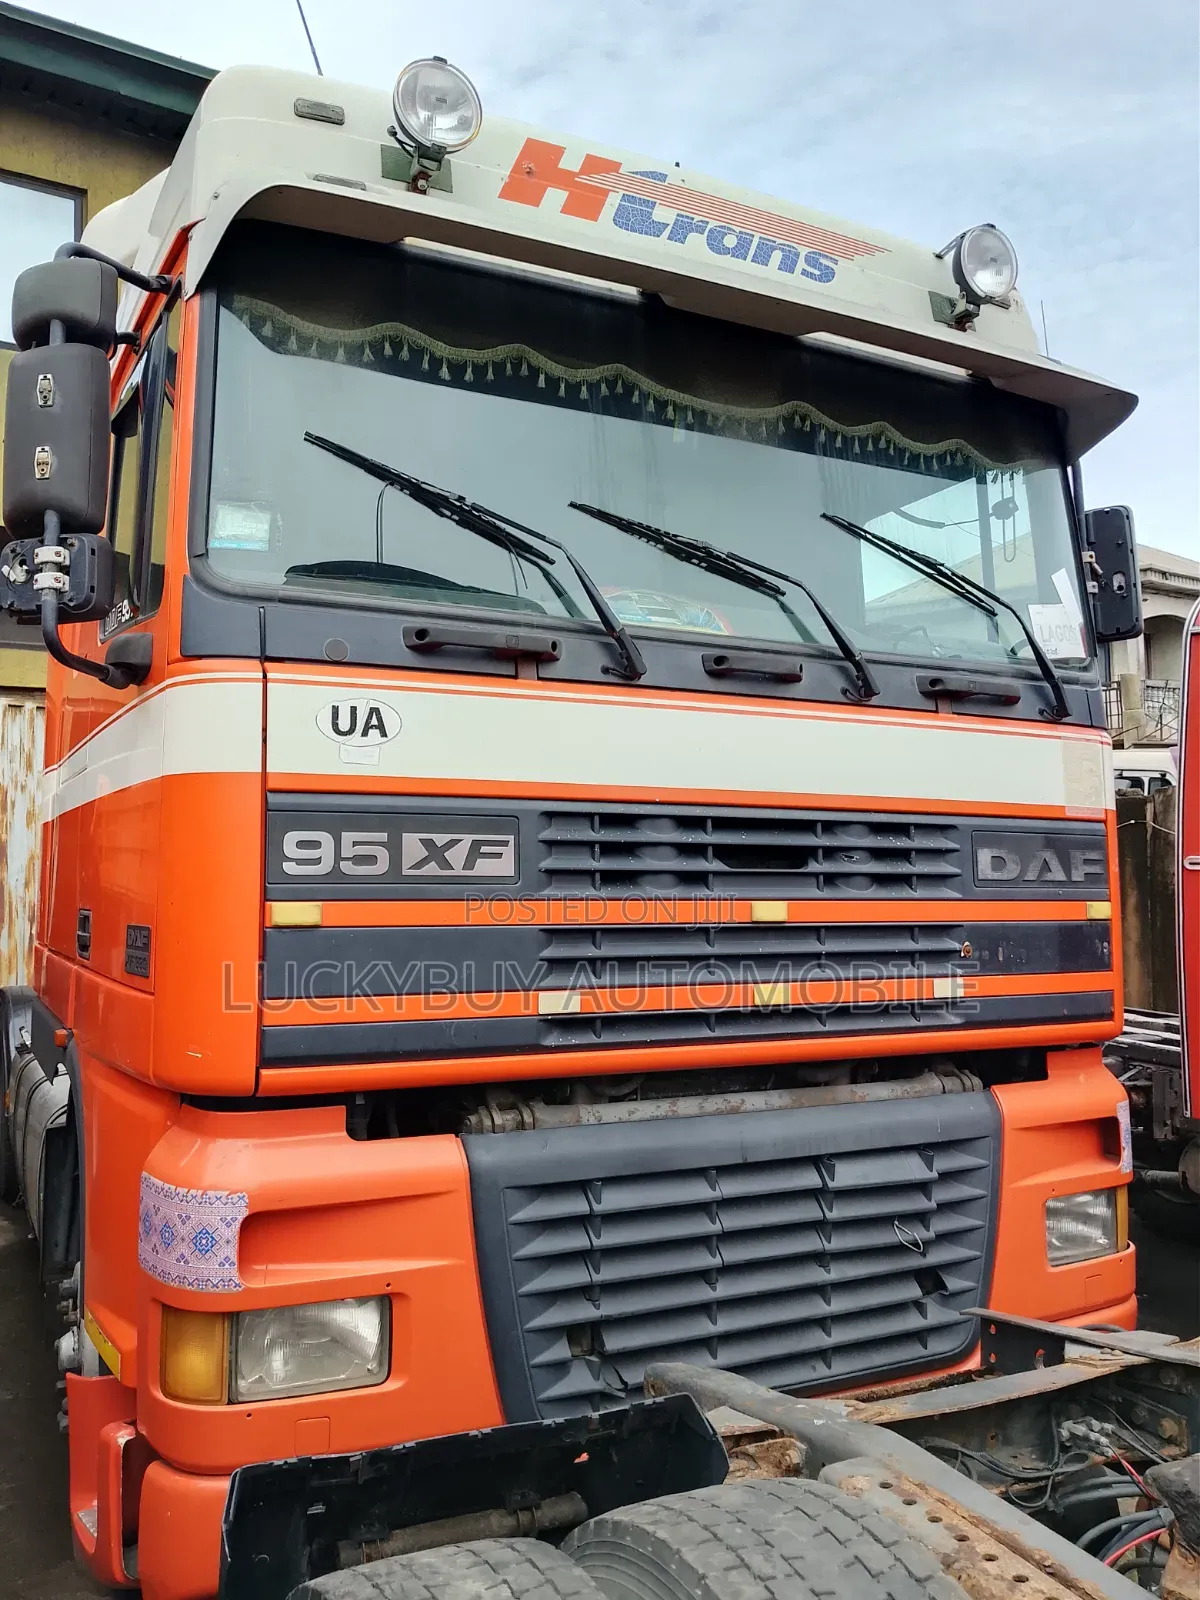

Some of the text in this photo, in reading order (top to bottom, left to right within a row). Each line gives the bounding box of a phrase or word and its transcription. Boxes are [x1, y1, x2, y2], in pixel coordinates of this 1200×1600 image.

[331, 704, 388, 738] UA
[282, 831, 510, 876] 95 XF
[976, 848, 1105, 882] DAF
